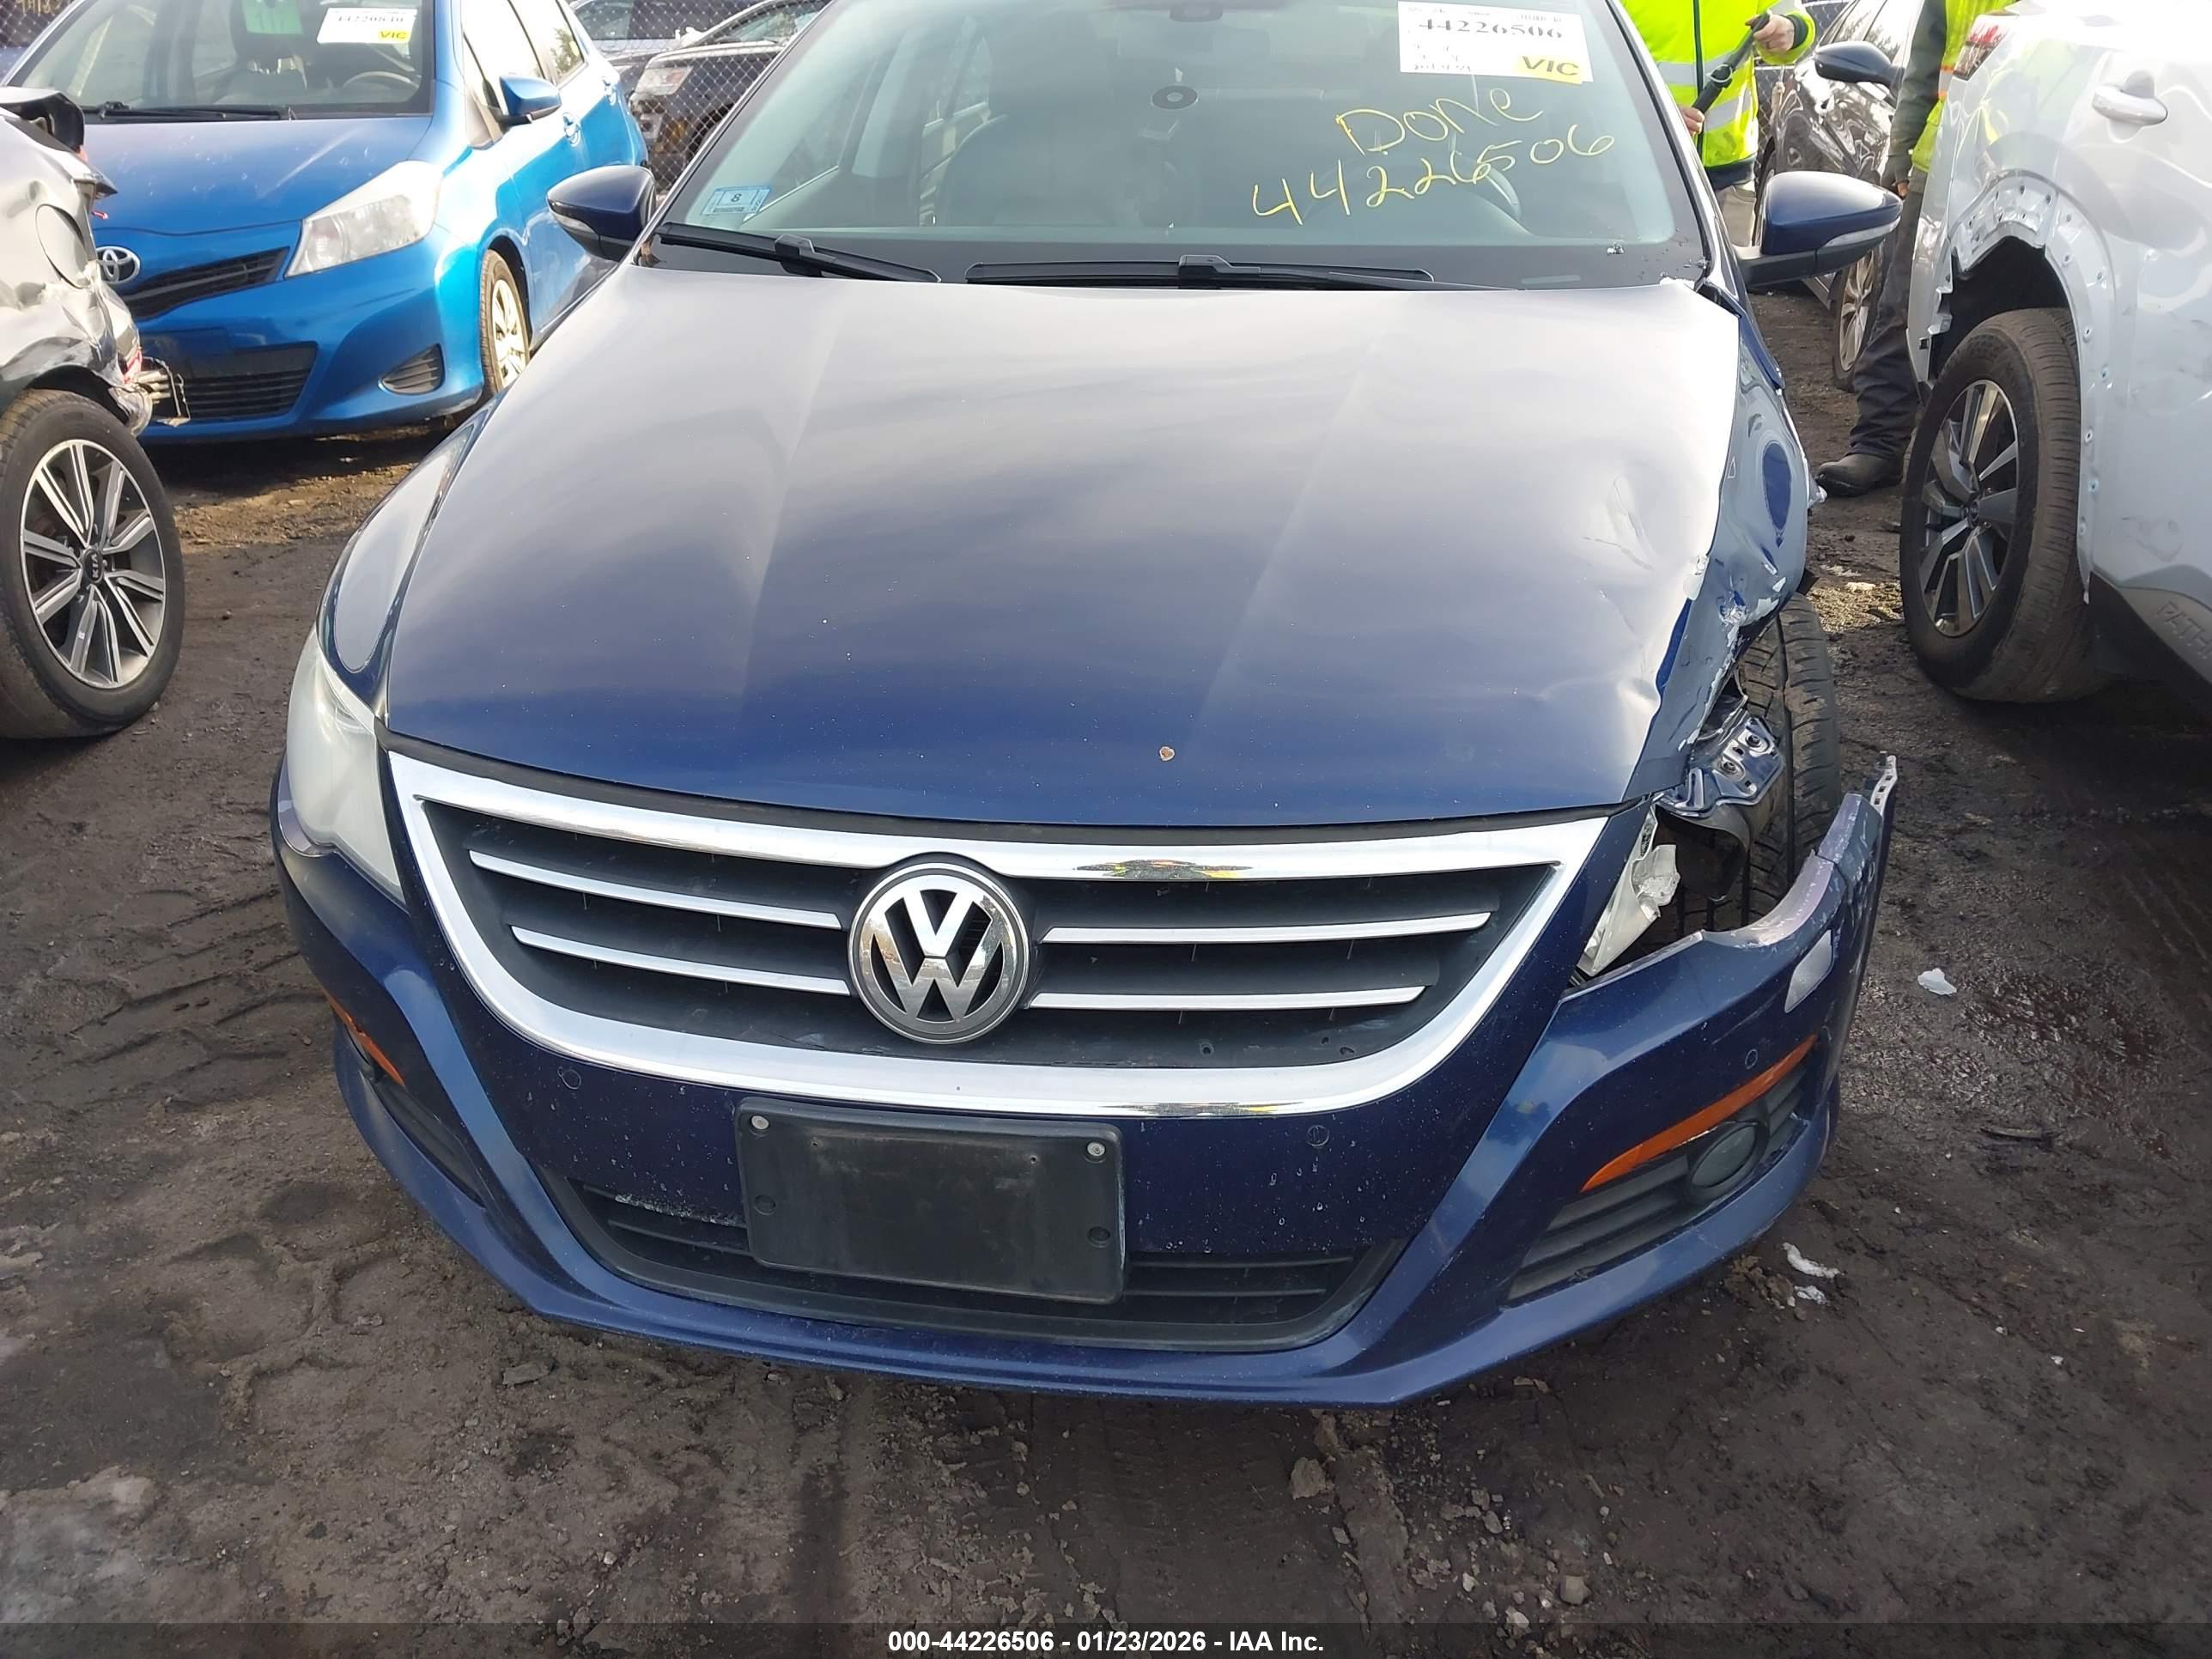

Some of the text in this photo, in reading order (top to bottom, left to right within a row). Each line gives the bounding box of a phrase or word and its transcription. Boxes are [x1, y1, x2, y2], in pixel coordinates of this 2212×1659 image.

[380, 31, 406, 40] VIC
[1419, 18, 1563, 39] 44226506
[1522, 55, 1580, 76] VIC
[1252, 124, 1615, 226] 44226506
[730, 192, 743, 203] 8
[90, 552, 100, 579] KIA
[858, 871, 1021, 1035] VW
